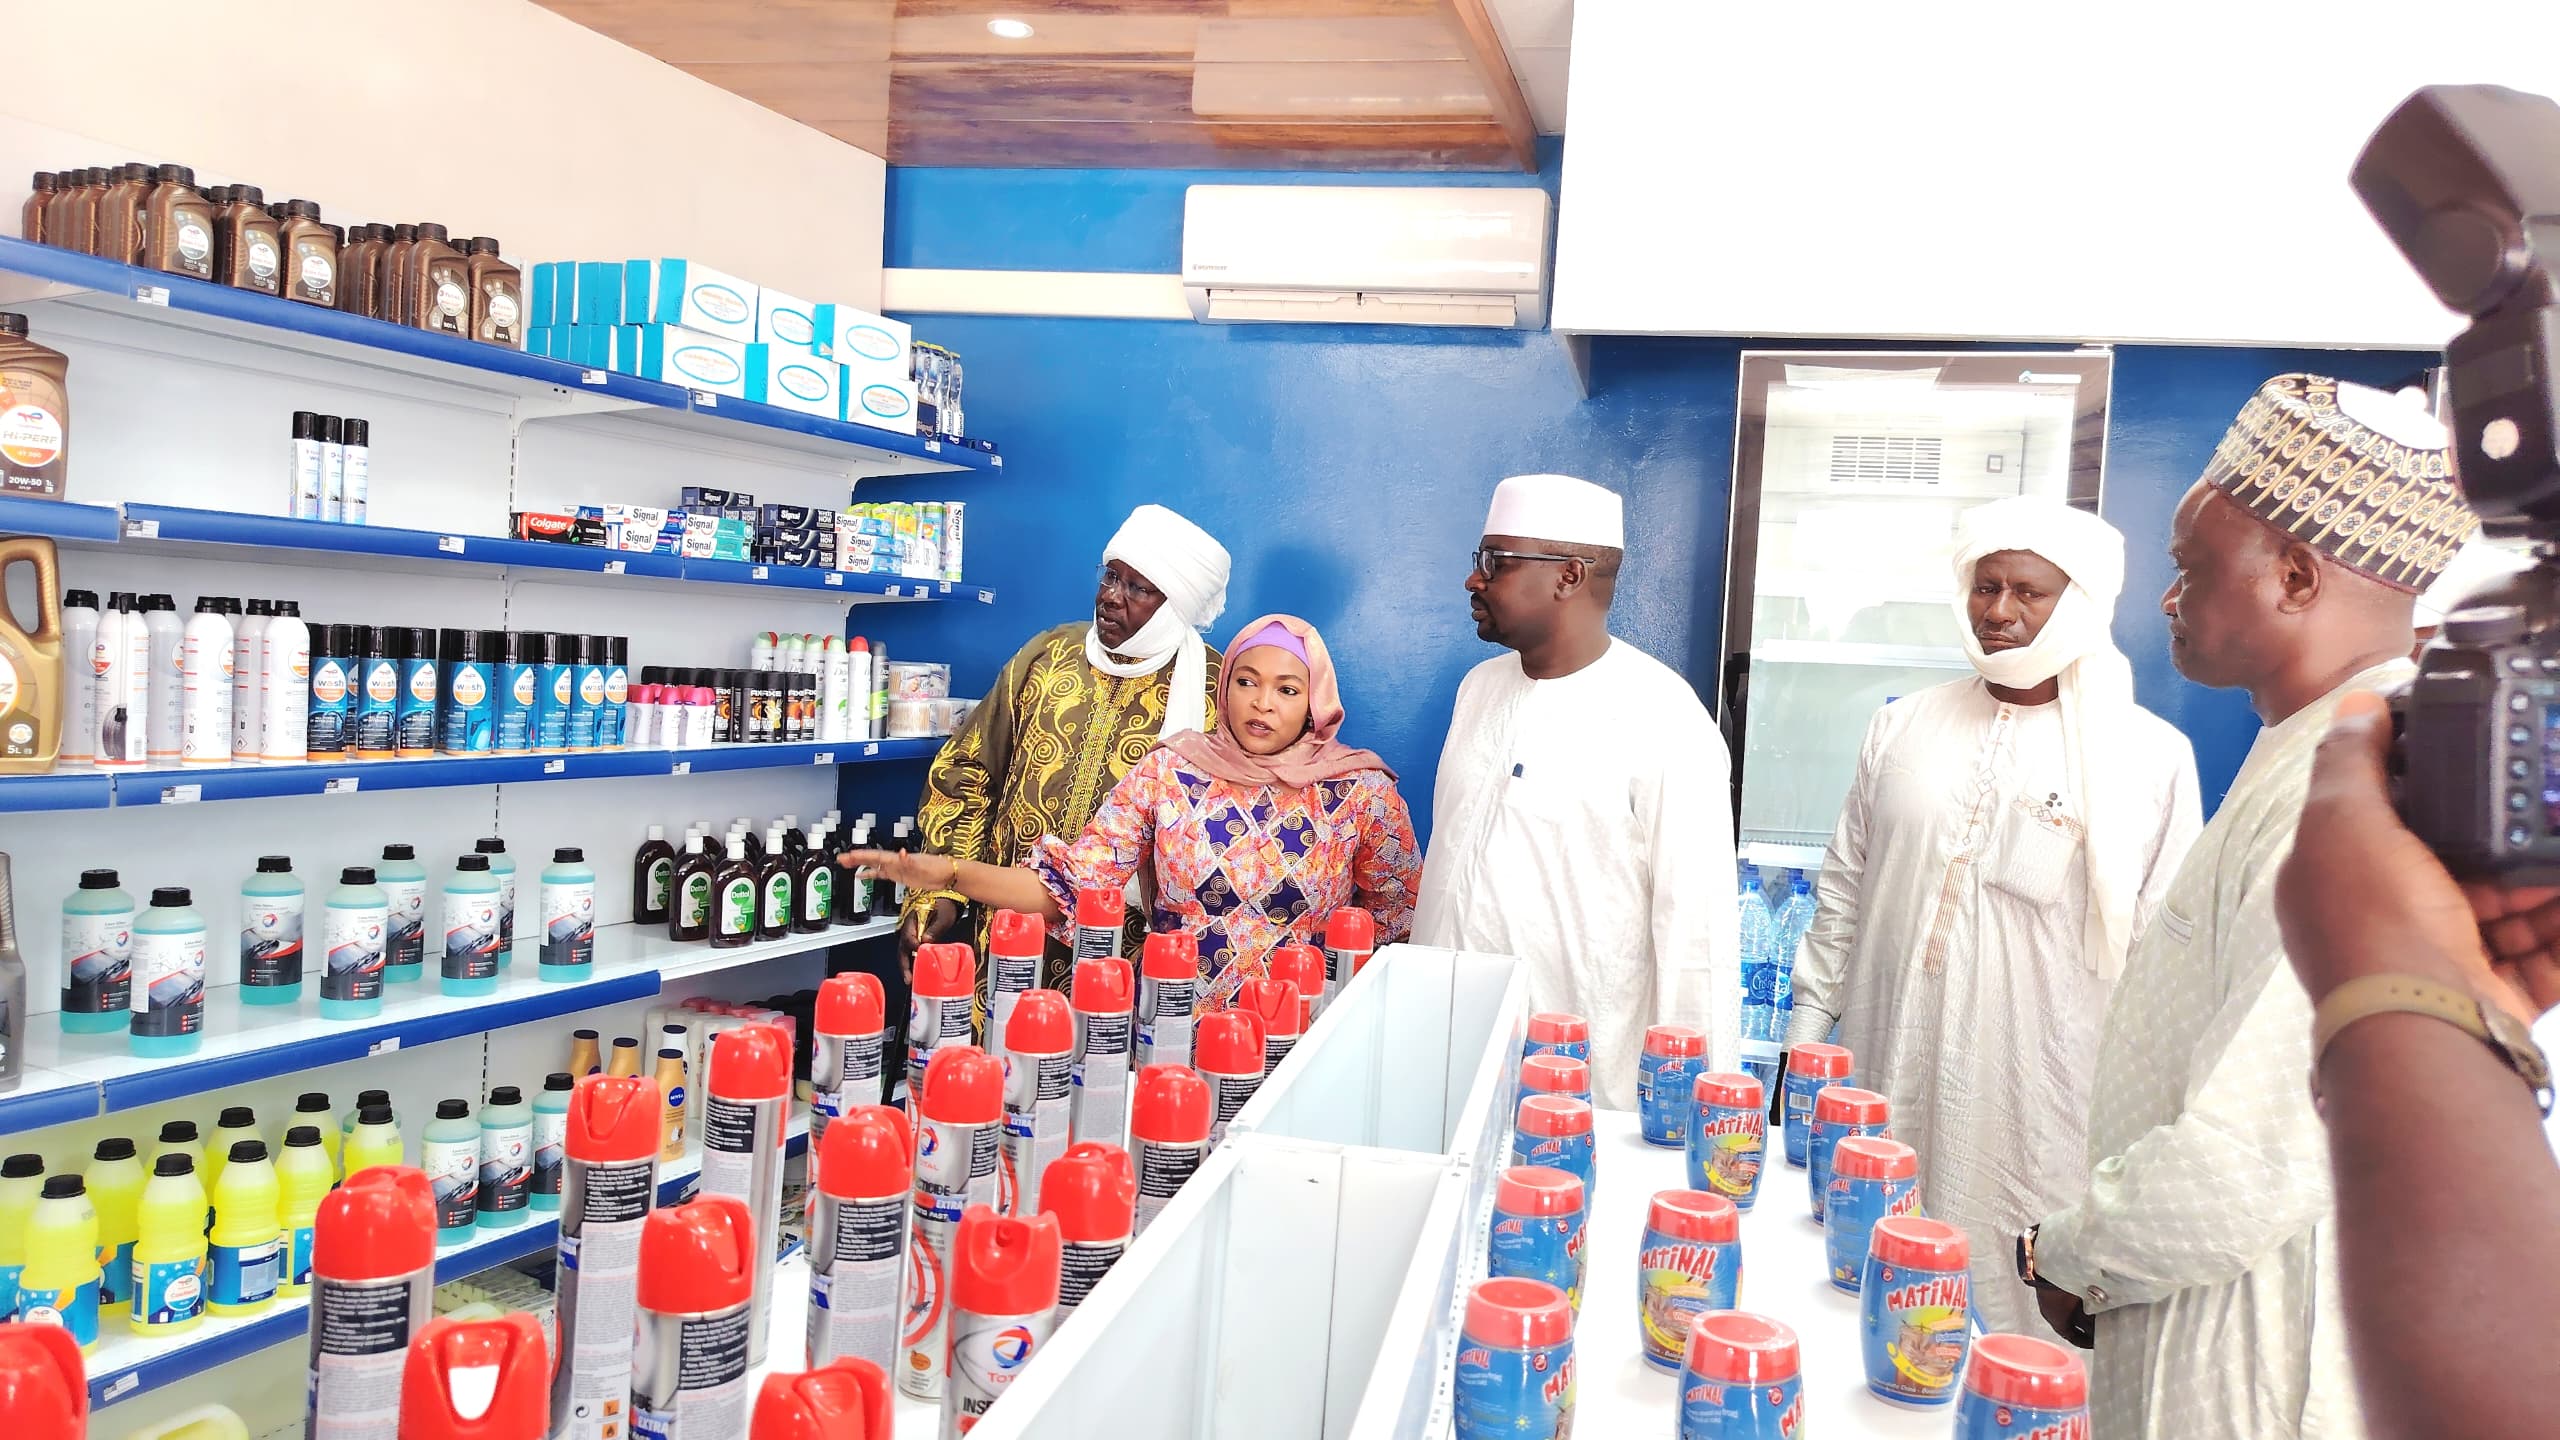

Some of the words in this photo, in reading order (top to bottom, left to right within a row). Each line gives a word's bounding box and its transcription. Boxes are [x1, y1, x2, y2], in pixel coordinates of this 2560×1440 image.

[9, 476, 42, 487] 20W-50
[633, 508, 659, 523] Signal
[781, 510, 801, 521] Signal
[530, 516, 567, 533] Colgate
[688, 515, 713, 530] Signal
[836, 516, 859, 530] Signal
[952, 508, 962, 541] Signal
[626, 531, 652, 544] Signal
[780, 532, 800, 542] Signal
[850, 536, 872, 549] Signal
[686, 536, 711, 550] Signal
[784, 551, 803, 561] Signal
[848, 555, 869, 569] Signal
[318, 678, 344, 687] wash
[457, 683, 482, 691] wash
[8, 745, 22, 754] 5L
[690, 884, 707, 893] Dettol
[814, 879, 829, 887] Dettol
[731, 890, 750, 899] Dettol
[773, 885, 788, 893] Dettol
[1010, 1117, 1031, 1127] EXTRA
[1532, 1141, 1562, 1155] MATINAL
[936, 1200, 963, 1210] EXTRA
[930, 1210, 948, 1219] FAST
[1495, 1219, 1522, 1235] MATINAL
[1460, 1348, 1490, 1369] MATINAL
[1687, 1385, 1723, 1406] MATINAL
